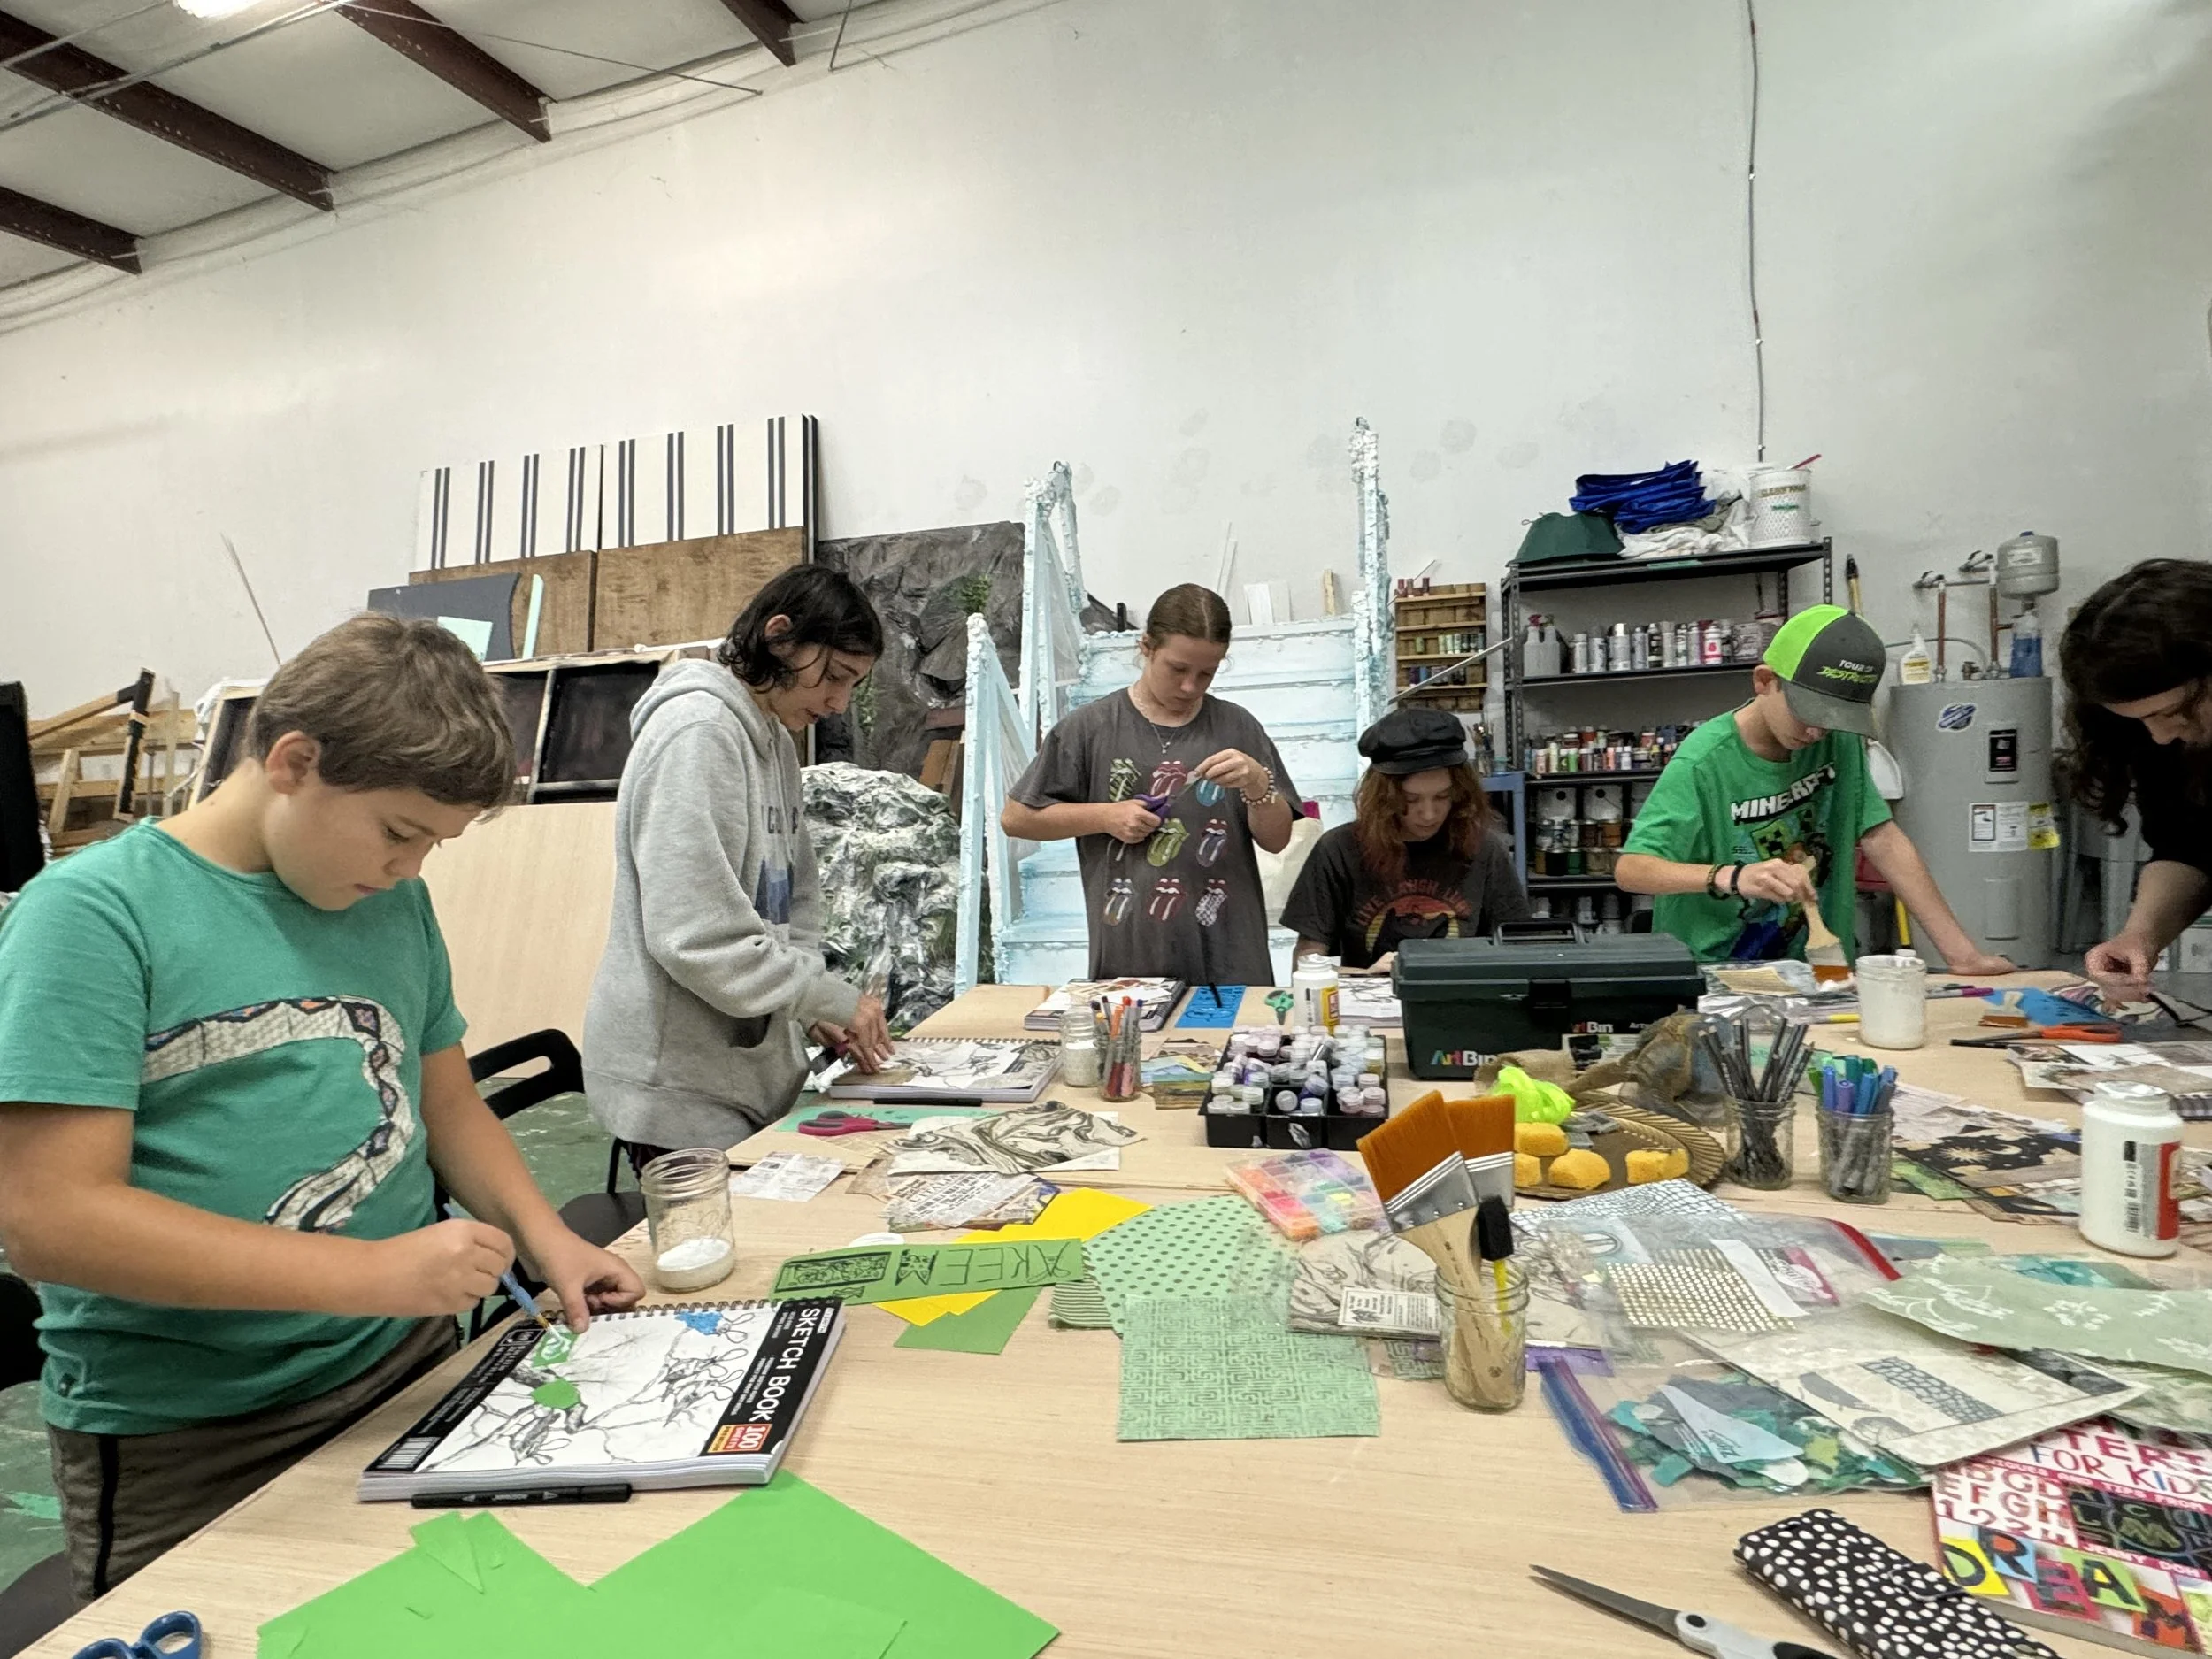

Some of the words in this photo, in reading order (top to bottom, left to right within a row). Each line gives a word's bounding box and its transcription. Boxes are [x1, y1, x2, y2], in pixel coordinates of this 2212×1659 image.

[1431, 1049, 1497, 1067] ArtBin
[776, 1307, 821, 1370] SKETCH
[749, 1375, 791, 1422] BOOK
[738, 1426, 766, 1448] 100
[2030, 1443, 2113, 1479] FOR
[2127, 1464, 2212, 1501] KIDS
[2085, 1543, 2145, 1564] JENNY
[2158, 1560, 2200, 1578] DOH
